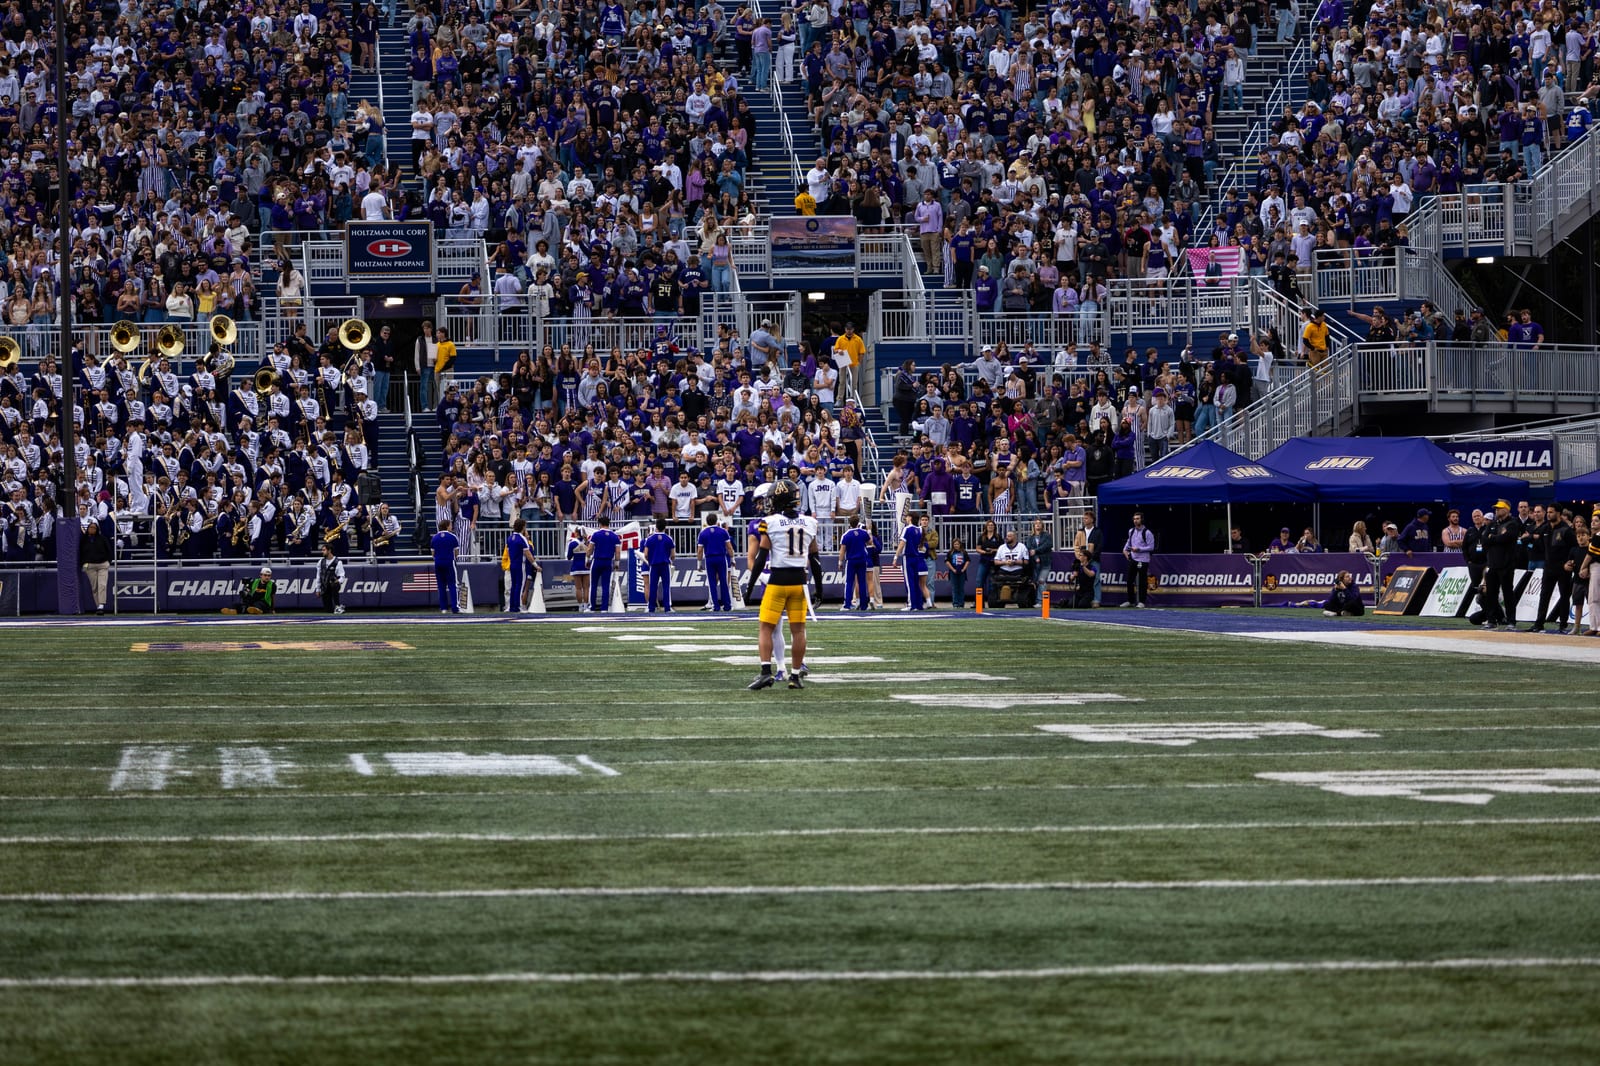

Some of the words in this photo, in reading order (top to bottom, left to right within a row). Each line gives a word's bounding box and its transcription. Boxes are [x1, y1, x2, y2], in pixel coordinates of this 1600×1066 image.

[658, 286, 672, 297] 24
[1306, 457, 1373, 470] JMU
[1146, 466, 1215, 478] JMU
[1227, 466, 1274, 478] JMU
[724, 490, 736, 502] 25
[960, 487, 973, 500] 25
[786, 527, 804, 557] 11
[1159, 574, 1252, 586] DOORGORILLA
[1278, 573, 1373, 585] DOORGOLA
